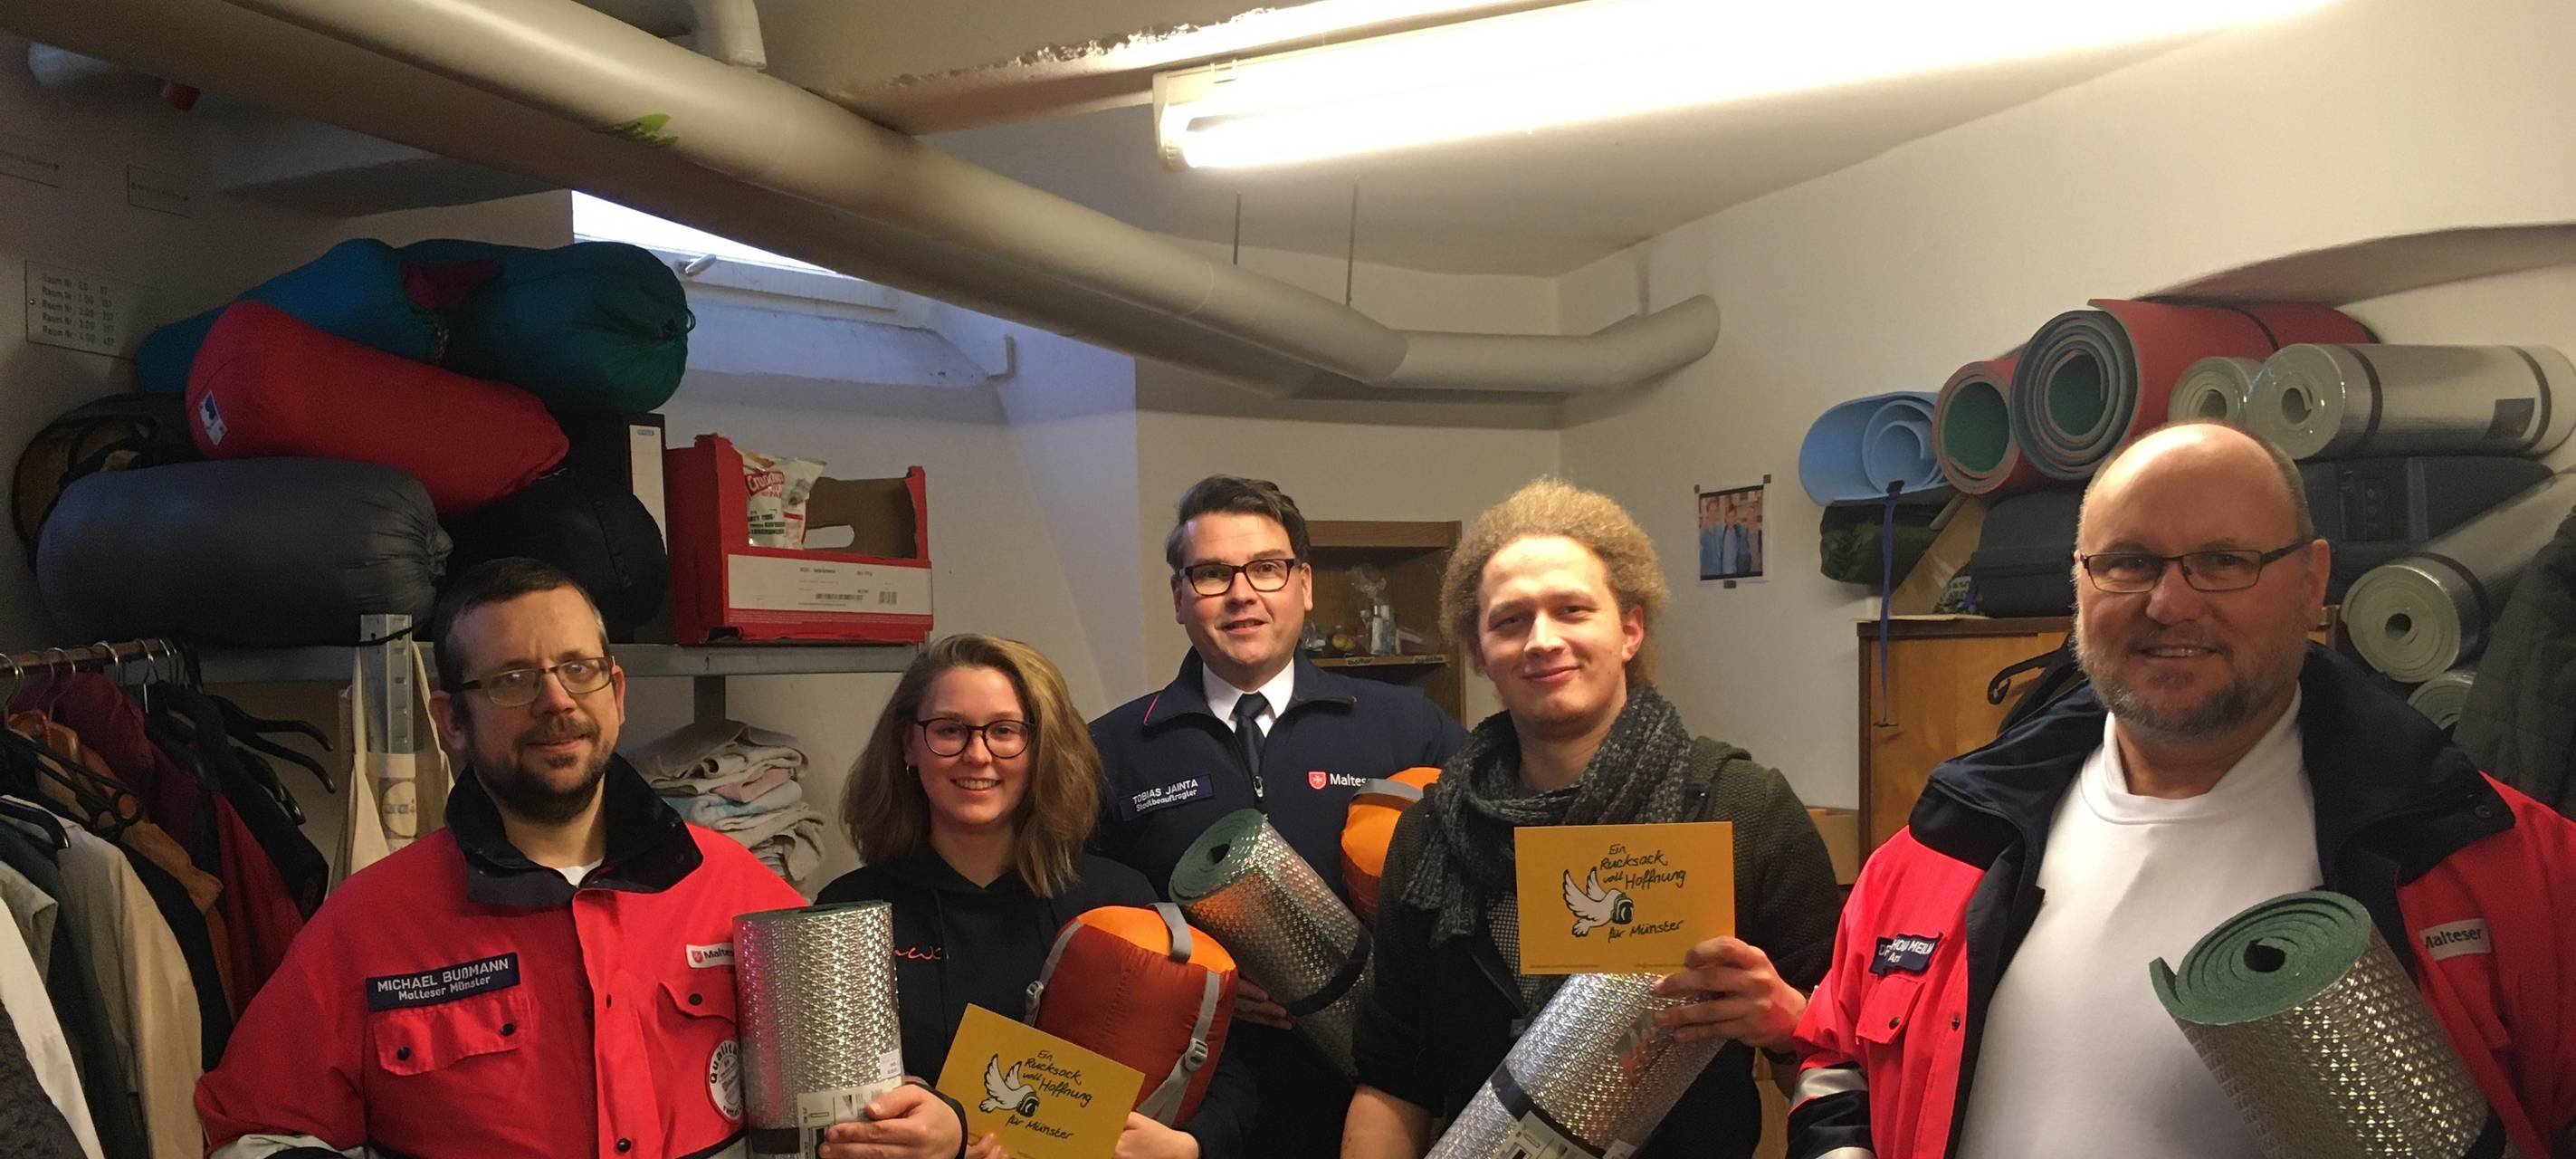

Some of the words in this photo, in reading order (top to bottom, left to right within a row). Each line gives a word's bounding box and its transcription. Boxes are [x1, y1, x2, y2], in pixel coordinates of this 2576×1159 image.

[1132, 788, 1162, 804] TOBIAS
[1165, 779, 1198, 795] JAINTA
[1599, 849, 1668, 870] Rucksack
[1608, 843, 1627, 856] Ein
[1625, 869, 1686, 889] Hoffnung
[1629, 920, 1684, 937] Münster
[377, 974, 438, 993] MICHAEL
[398, 986, 446, 1001] Malteser
[450, 976, 491, 993] Münster
[1037, 1049, 1053, 1061] Ein
[1025, 1058, 1083, 1085] Rucksack
[1039, 1078, 1092, 1108] Hoffnung
[1026, 1120, 1074, 1140] Münster
